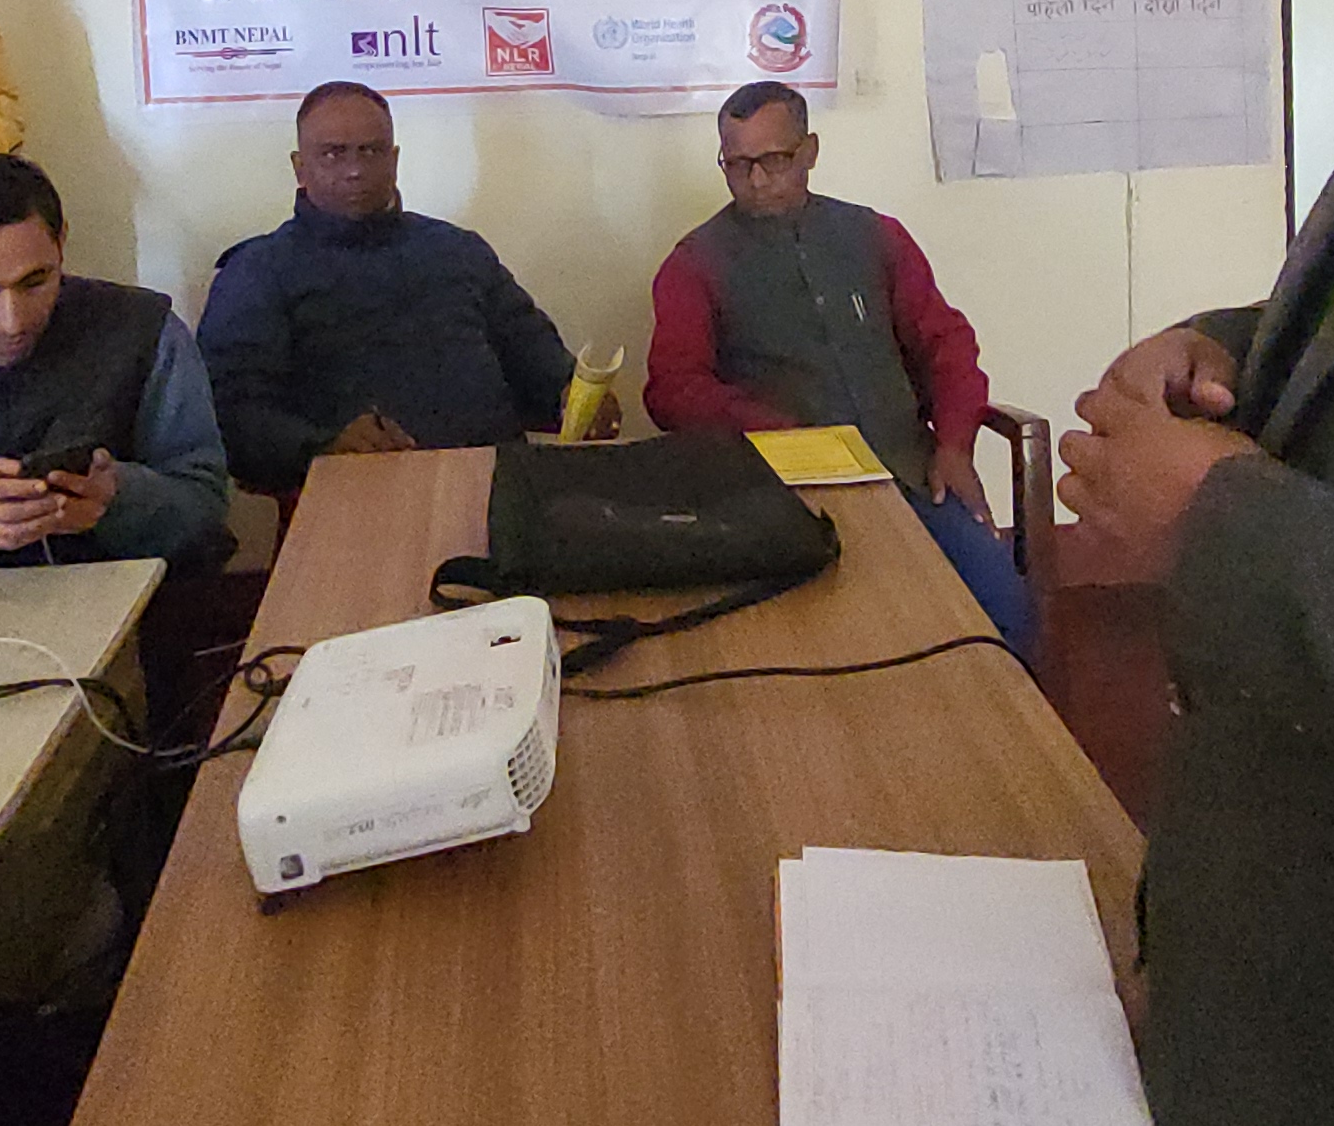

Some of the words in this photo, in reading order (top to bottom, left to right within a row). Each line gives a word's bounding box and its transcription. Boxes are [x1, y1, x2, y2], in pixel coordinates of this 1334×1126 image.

[175, 28, 229, 45] BNMT
[234, 26, 293, 44] NEPAL
[383, 15, 441, 57] nlt
[496, 47, 540, 63] NLR
